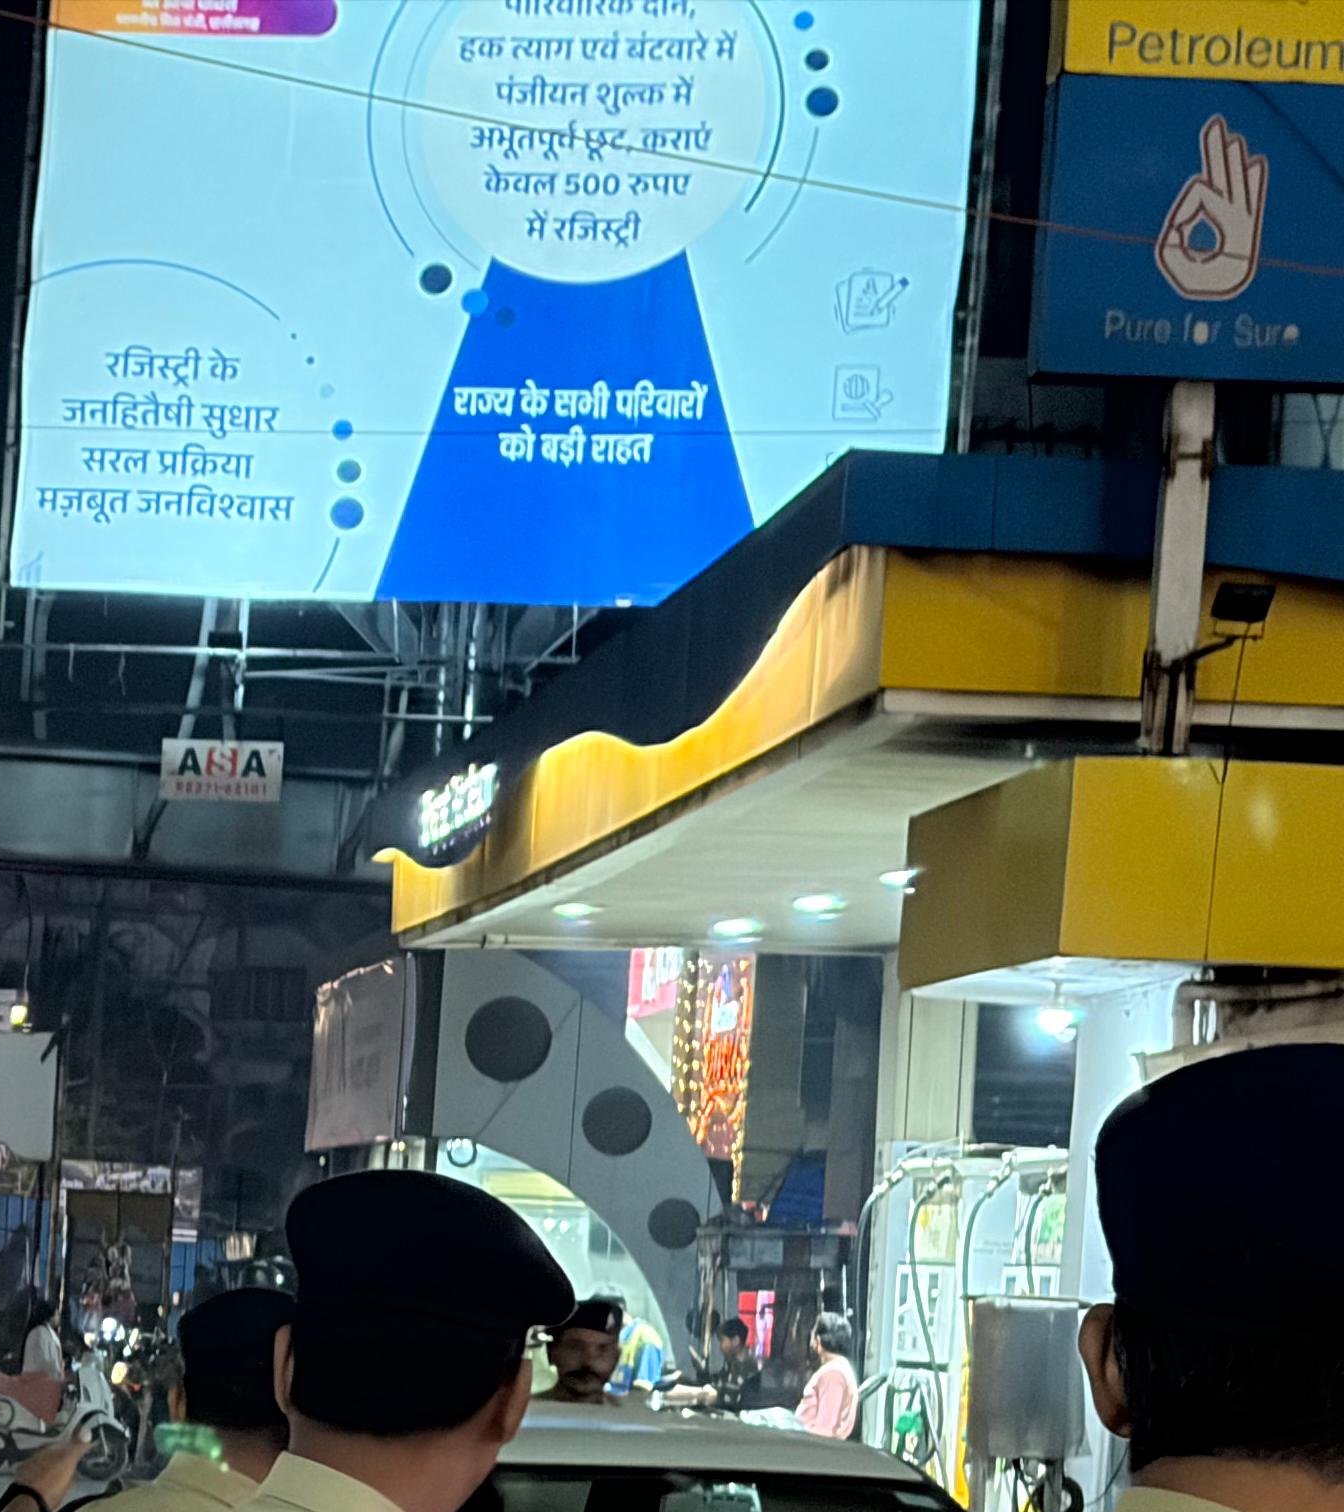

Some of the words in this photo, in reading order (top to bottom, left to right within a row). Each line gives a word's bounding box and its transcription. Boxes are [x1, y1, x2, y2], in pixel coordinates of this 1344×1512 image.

[458, 36, 506, 62] हक
[511, 37, 574, 61] त्याग
[580, 31, 619, 61] एवं
[625, 30, 709, 61] बंटवारे
[715, 30, 738, 61] में
[1108, 21, 1344, 71] Petroleum
[496, 74, 589, 106] पंजीयन
[596, 82, 667, 115] शुल्क
[672, 75, 695, 106] में
[470, 120, 576, 161] अभूतपूर्व
[484, 164, 558, 196] केवल
[564, 173, 620, 196] 500
[628, 172, 691, 196] रुपए
[526, 210, 548, 241] में
[553, 210, 642, 247] रजिस्ट्री
[1104, 309, 1170, 342] Pure
[1183, 312, 1222, 347] for
[1233, 313, 1300, 348] Sure
[105, 345, 202, 387] रजिस्ट्री
[208, 348, 240, 382] के
[62, 391, 194, 430] जनहितैषी
[200, 403, 280, 439] सुधार
[454, 387, 515, 417] राज्य
[519, 379, 550, 418] के
[554, 380, 611, 419] सभी
[615, 380, 708, 422] परिवारों
[81, 447, 151, 474] सरल
[157, 443, 254, 479] प्रक्रिया
[498, 423, 536, 463] को
[540, 425, 586, 468] बड़ी
[591, 433, 654, 464] राहत
[36, 487, 131, 524] मज़बूत
[136, 484, 295, 521] जनविश्वास
